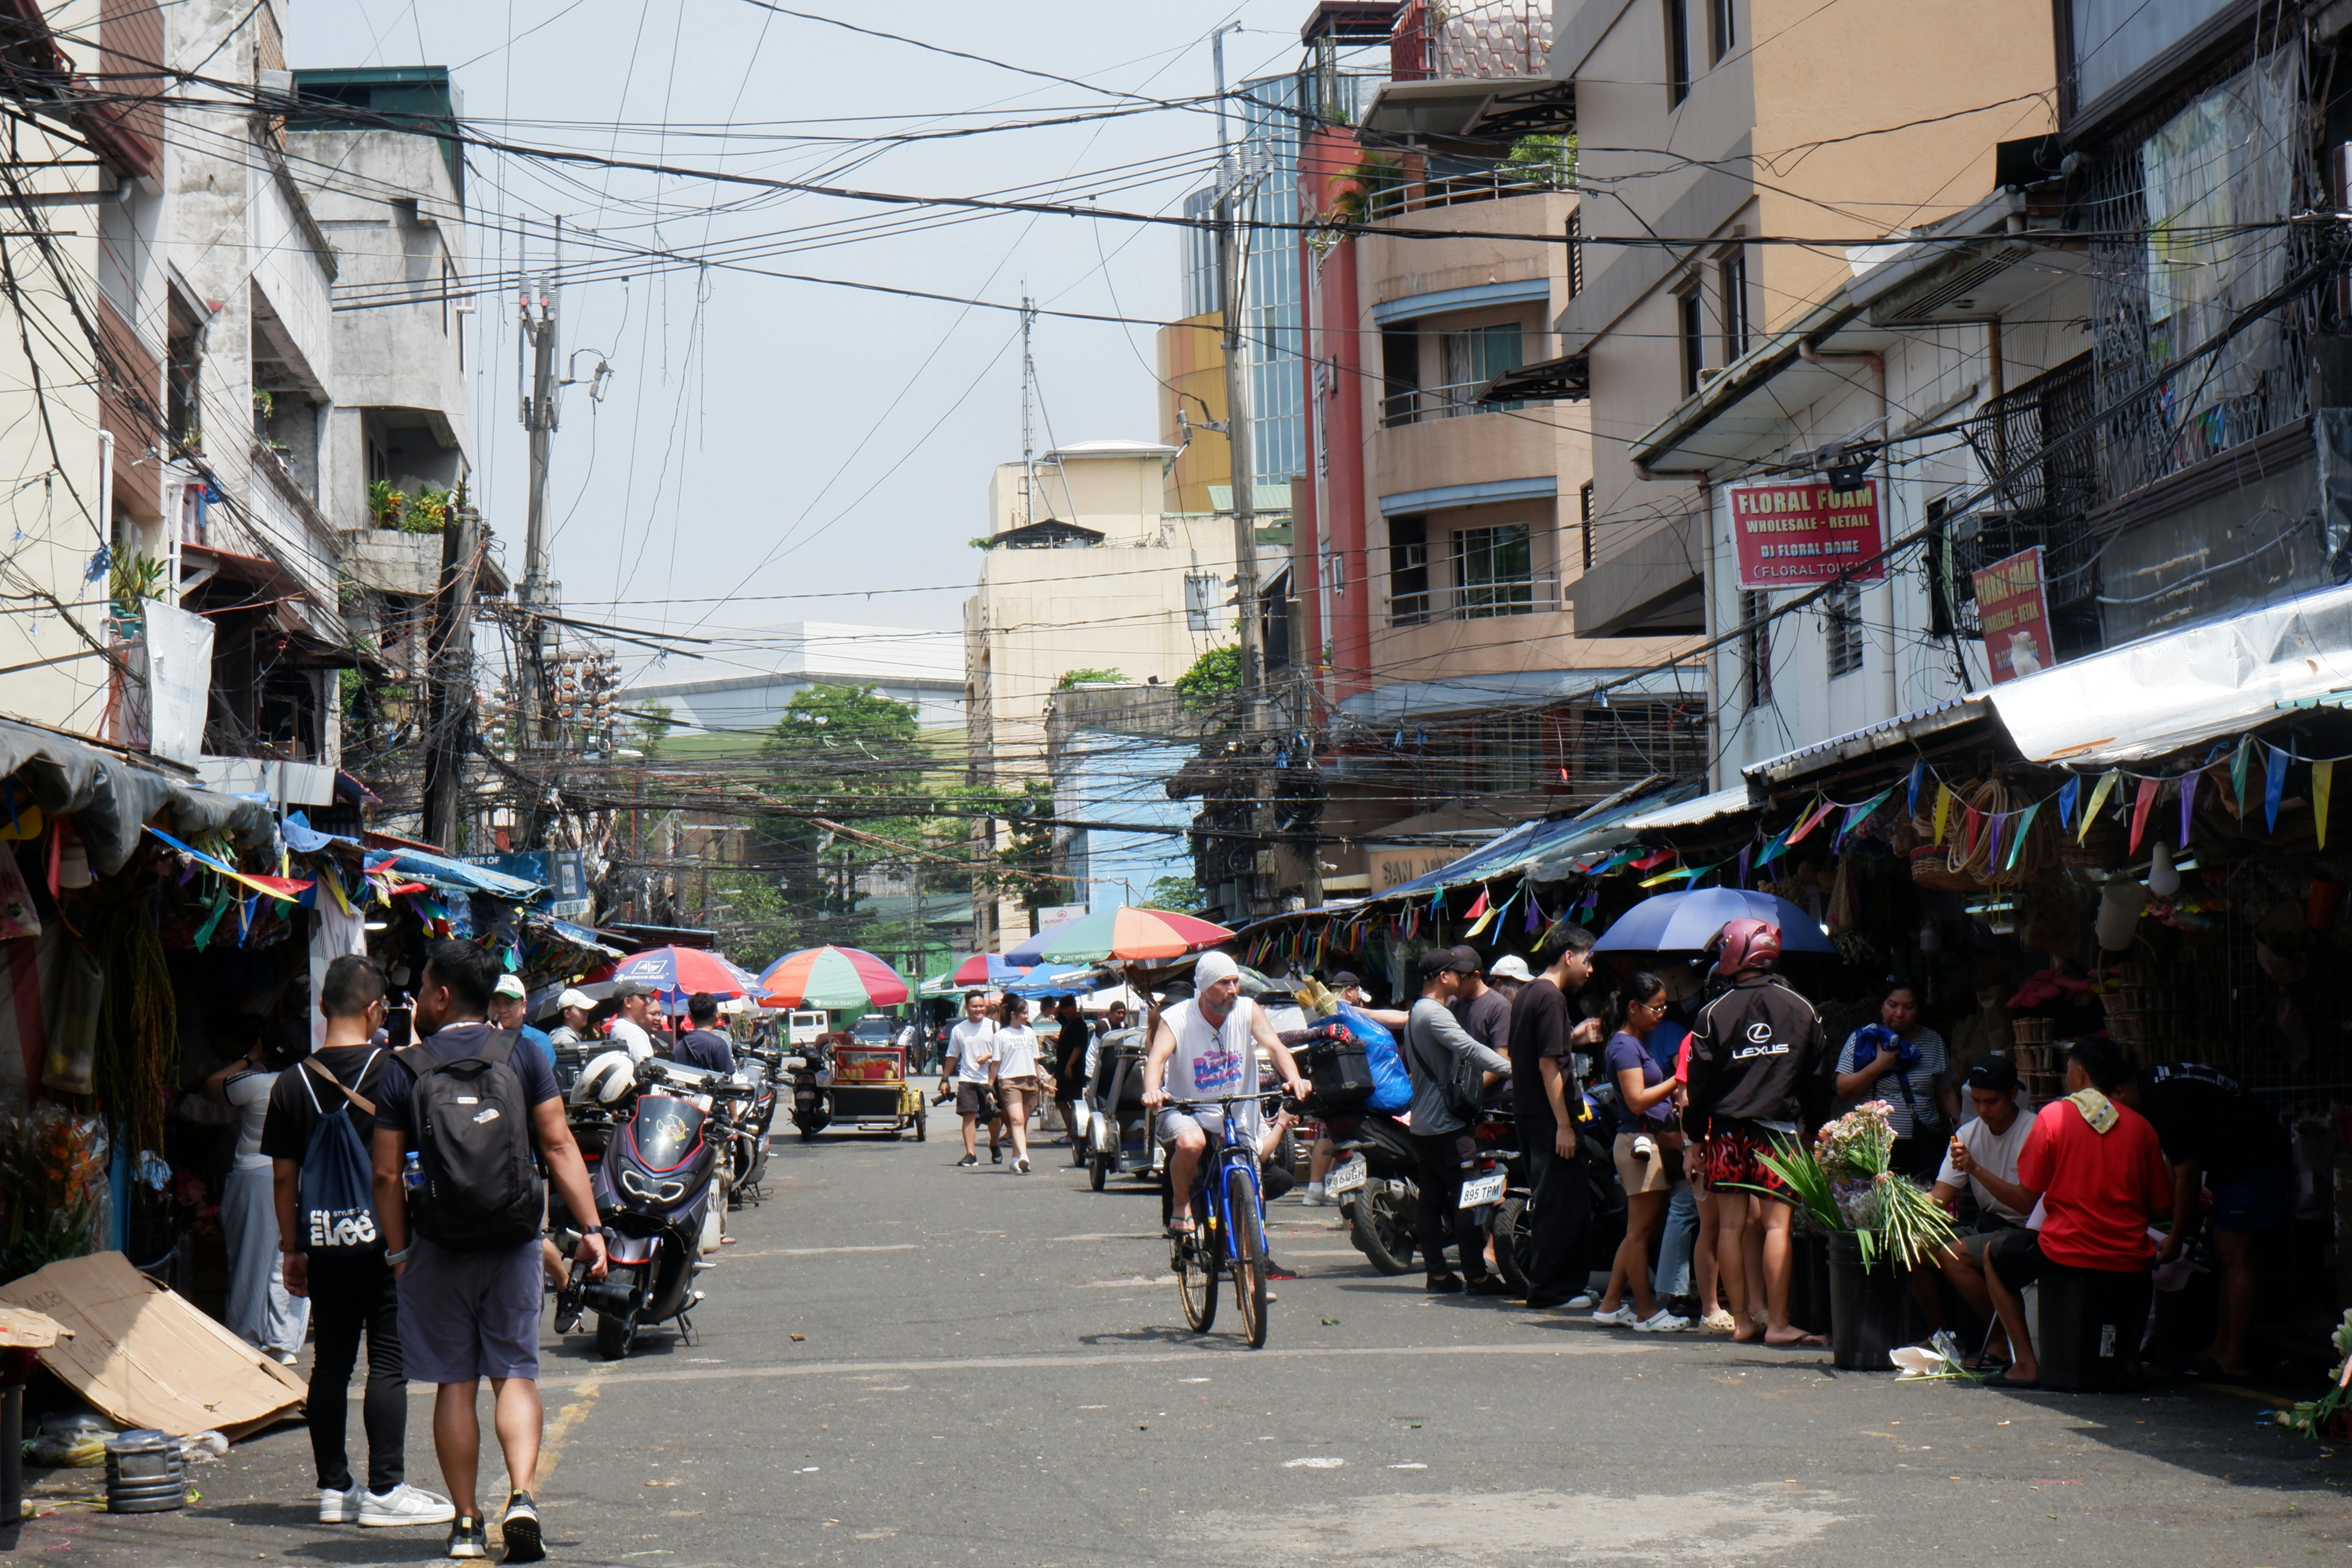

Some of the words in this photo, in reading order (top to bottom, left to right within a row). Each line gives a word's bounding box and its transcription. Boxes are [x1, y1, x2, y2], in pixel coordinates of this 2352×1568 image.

[1739, 491, 1811, 515] FLORAL
[1817, 486, 1873, 510] FOAM
[1746, 517, 1817, 534] WHOLESALE
[1829, 514, 1871, 529] RETAIL
[1761, 545, 1775, 558] DJ
[1778, 543, 1822, 557] FLORAL
[1824, 540, 1860, 555] DOME
[1975, 569, 2009, 607] FLORAL
[2008, 559, 2038, 596] FOAM
[1984, 608, 2015, 635] WHOLESALE
[2018, 600, 2040, 623] RETAIL
[457, 857, 485, 866] OWER
[487, 856, 500, 865] OF
[1382, 860, 1413, 885] SAN
[1733, 1044, 1789, 1059] LEXUS
[1464, 1188, 1479, 1201] 895
[1482, 1184, 1500, 1198] TPM
